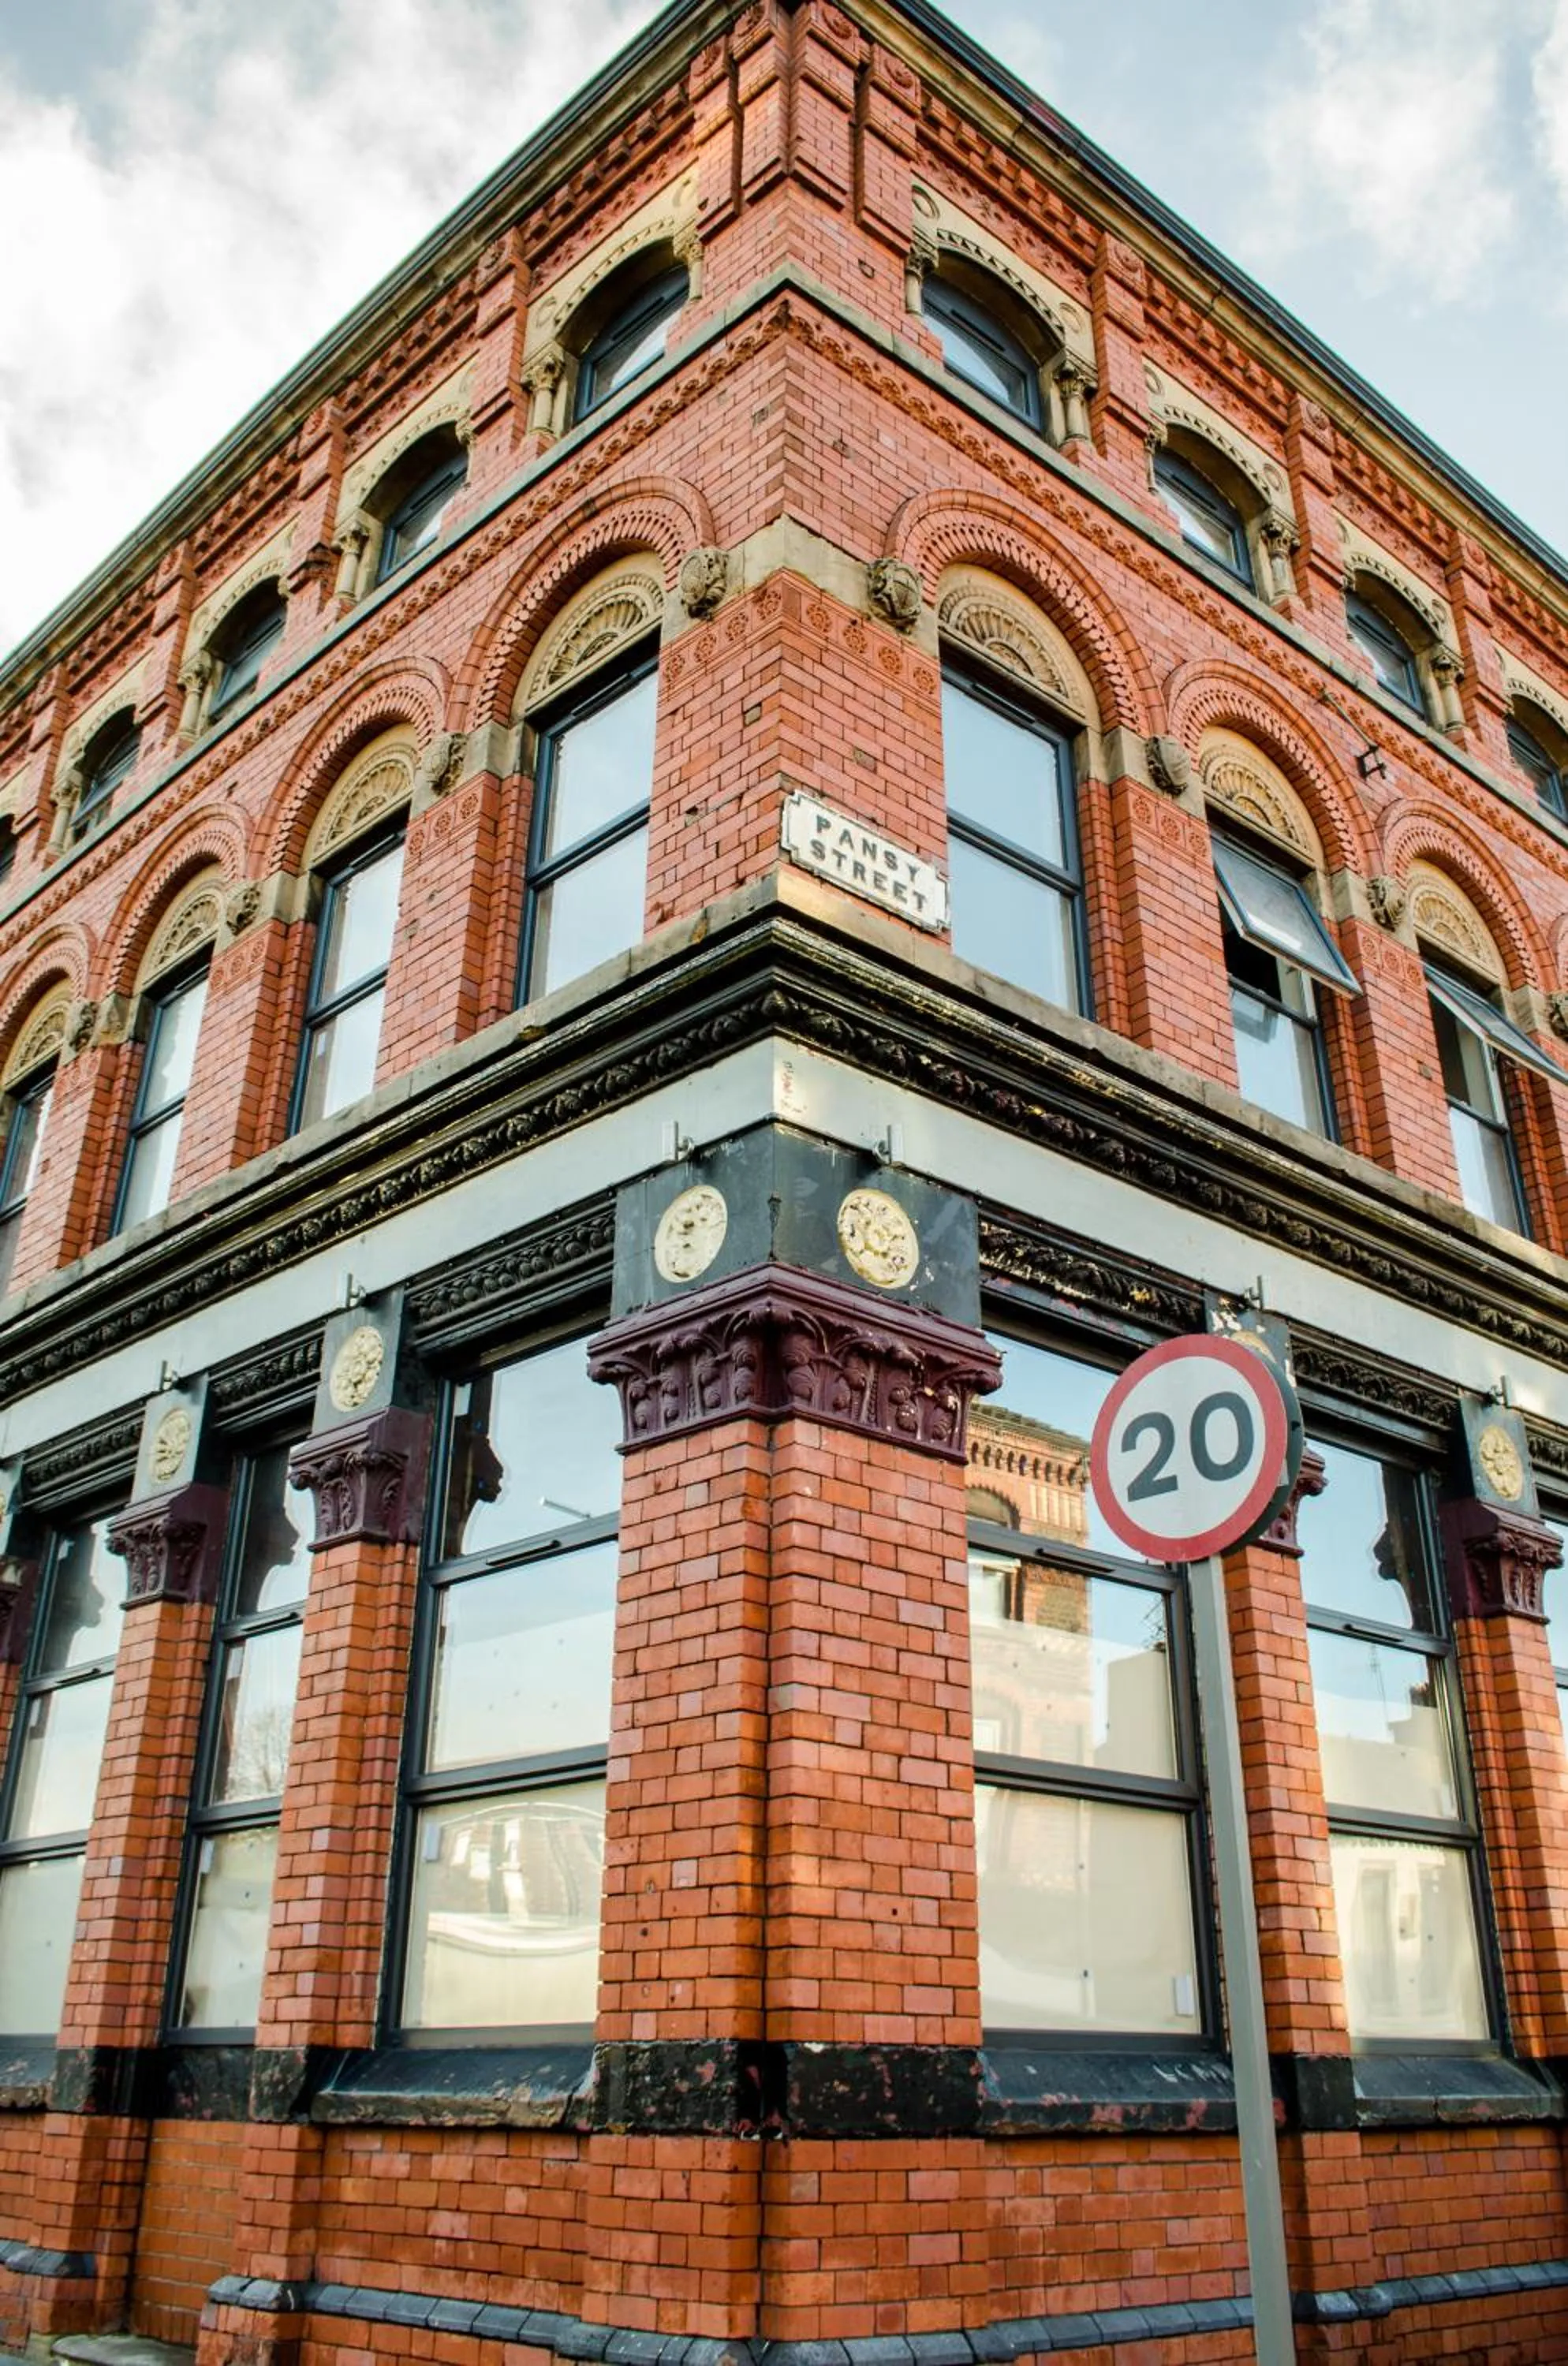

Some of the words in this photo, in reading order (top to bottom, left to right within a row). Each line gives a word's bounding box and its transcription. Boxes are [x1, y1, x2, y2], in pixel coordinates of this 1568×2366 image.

[810, 839, 928, 912] STREET
[816, 814, 920, 882] PANSY
[1121, 1391, 1255, 1502] 20
